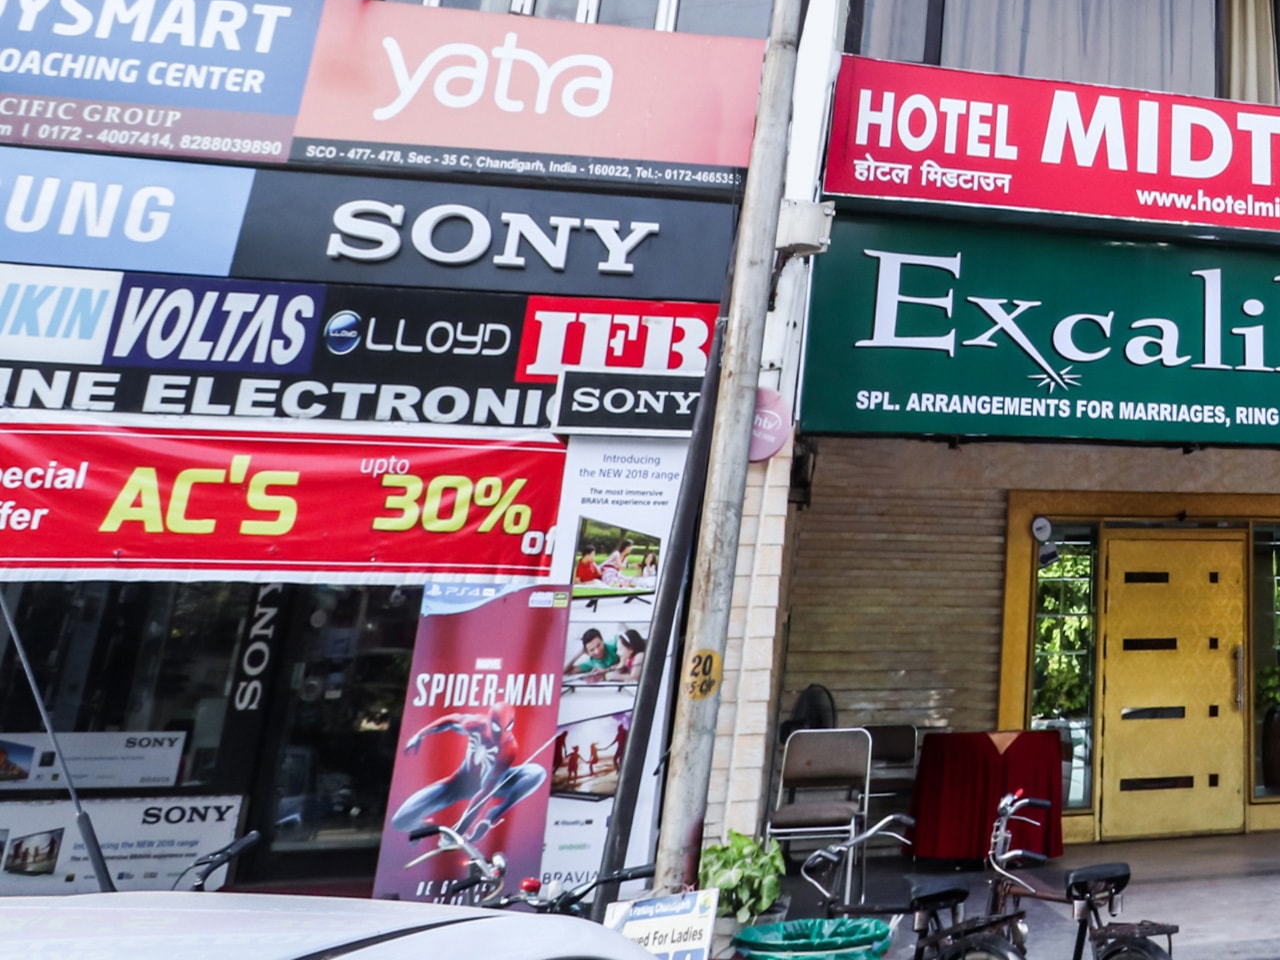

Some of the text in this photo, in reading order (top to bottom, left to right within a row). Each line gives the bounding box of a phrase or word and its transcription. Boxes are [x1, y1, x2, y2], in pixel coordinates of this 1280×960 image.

[0, 47, 266, 94] OACHING CENTER
[372, 32, 615, 121] yatra
[0, 97, 182, 129] CIFIC GROUP
[855, 88, 1019, 161] HOTEL
[38, 123, 83, 142] 0172
[96, 128, 174, 150] 4007414,
[180, 134, 283, 157] 8288039890
[305, 143, 337, 160] SCO
[378, 149, 404, 166] 478,
[408, 151, 432, 165] Sec
[442, 152, 458, 168] 35
[459, 153, 473, 170] C,
[476, 155, 546, 176] Chandigarh,
[549, 160, 578, 175] India
[588, 162, 632, 180] 160022,
[853, 152, 1012, 194] होटल मिडटाउन
[4, 174, 175, 243] UNG
[326, 199, 660, 275] SONY
[0, 283, 110, 340] IKIN
[112, 287, 315, 366] VOLTAS
[365, 316, 511, 356] LLOYD
[526, 310, 709, 375] IFB
[142, 374, 556, 427] ELECTRONI
[571, 386, 700, 415] SONY
[856, 390, 900, 411] SPL.
[906, 392, 1071, 419] ARRANGEMENTS
[1076, 399, 1114, 420] FOR
[1119, 401, 1231, 428] MARRIAGES,
[1236, 406, 1280, 426] RING
[0, 461, 89, 489] ecial
[360, 455, 410, 478] upto
[579, 468, 680, 481] the NEW 2018 range
[602, 453, 661, 467] Introducing
[98, 455, 300, 536] AC'S
[372, 474, 532, 535] 30%
[0, 500, 49, 531] fer
[235, 582, 284, 711] SONY
[690, 654, 713, 677] 20
[413, 673, 555, 708] SPIDER-MAN
[125, 737, 180, 749] SONY
[141, 805, 234, 825] SONY
[652, 930, 669, 947] For
[671, 926, 704, 944] Ladies
